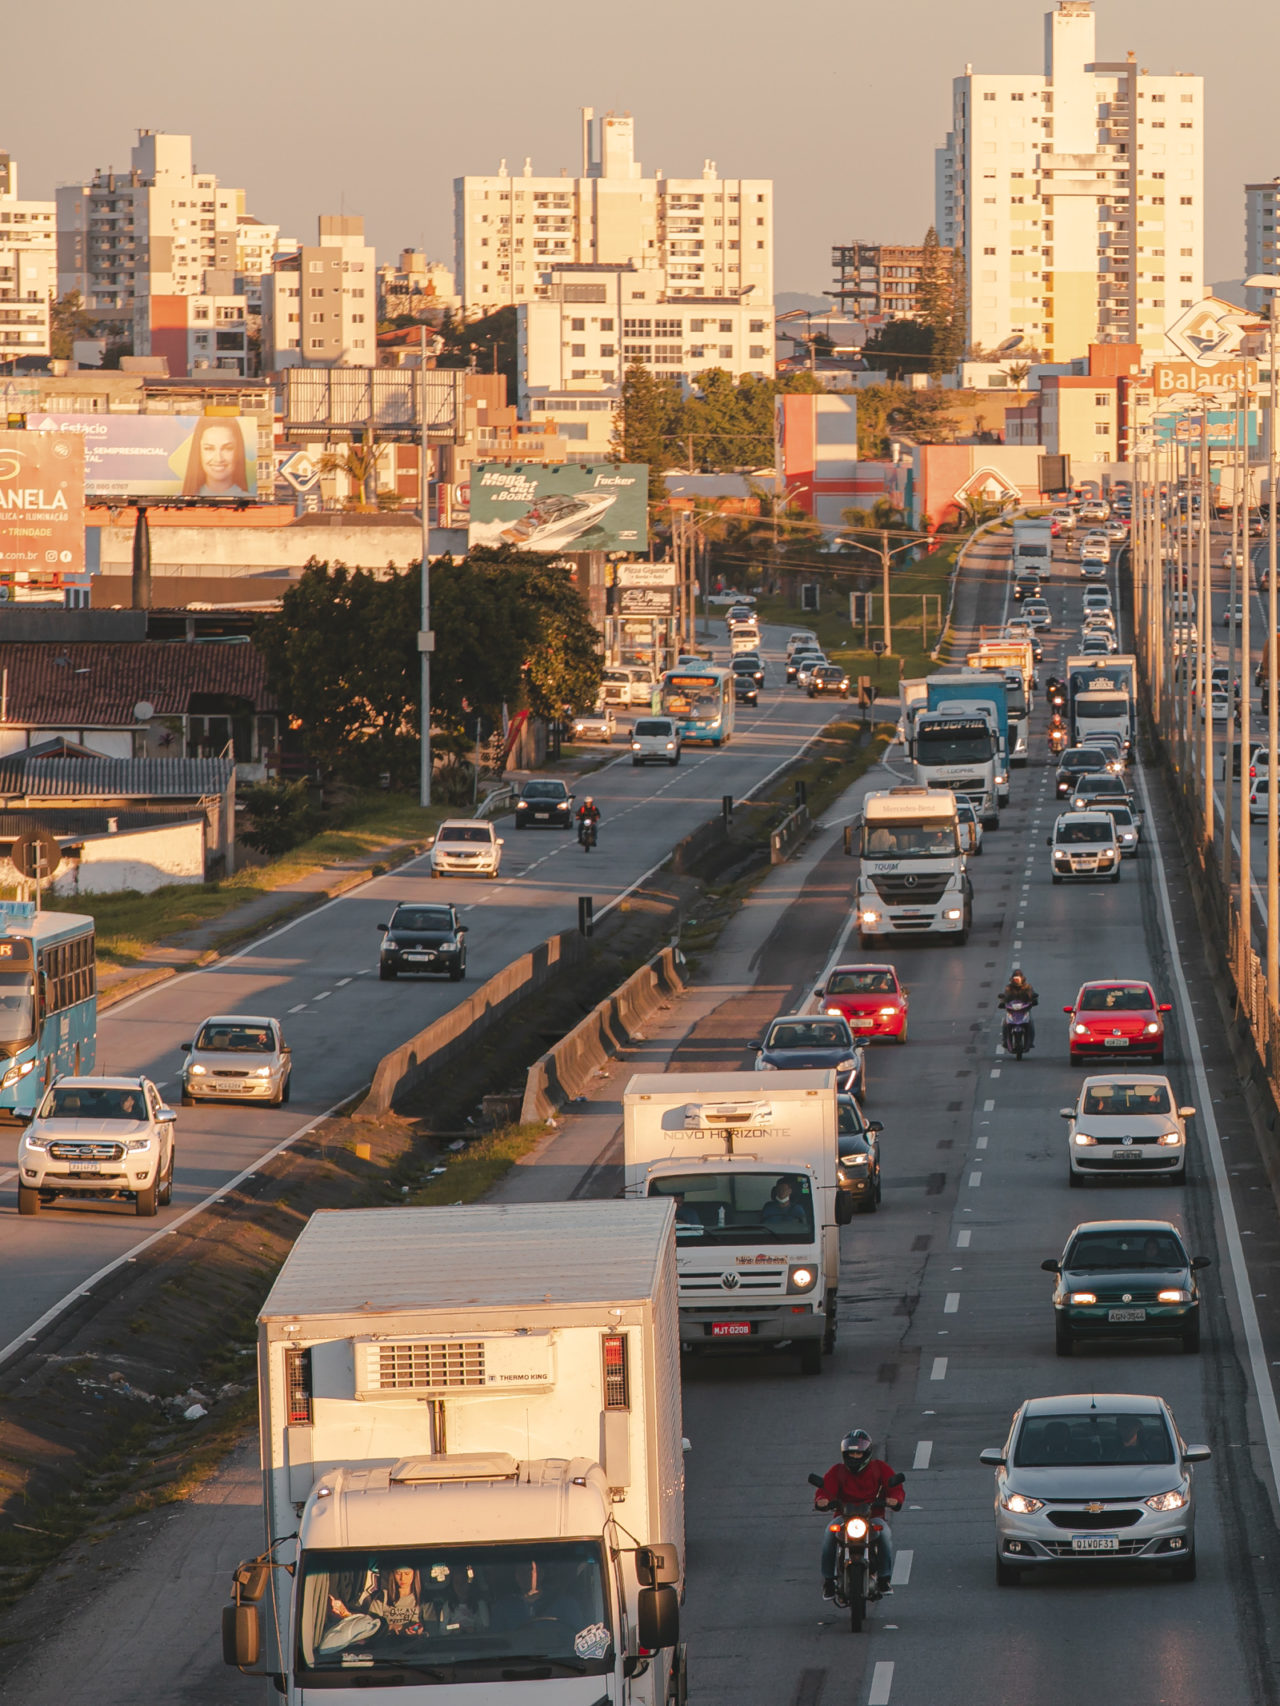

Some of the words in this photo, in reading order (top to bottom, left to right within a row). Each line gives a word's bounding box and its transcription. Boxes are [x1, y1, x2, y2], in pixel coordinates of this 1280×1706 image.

[1160, 366, 1252, 390] Balaroti
[481, 473, 527, 488] Mega
[499, 491, 534, 501] Boats
[9, 528, 53, 536] TRINDADE
[663, 1131, 705, 1141] NOVO
[710, 1128, 791, 1139] HORIZONTE
[500, 1373, 529, 1382] THERMO
[530, 1373, 548, 1381] KING
